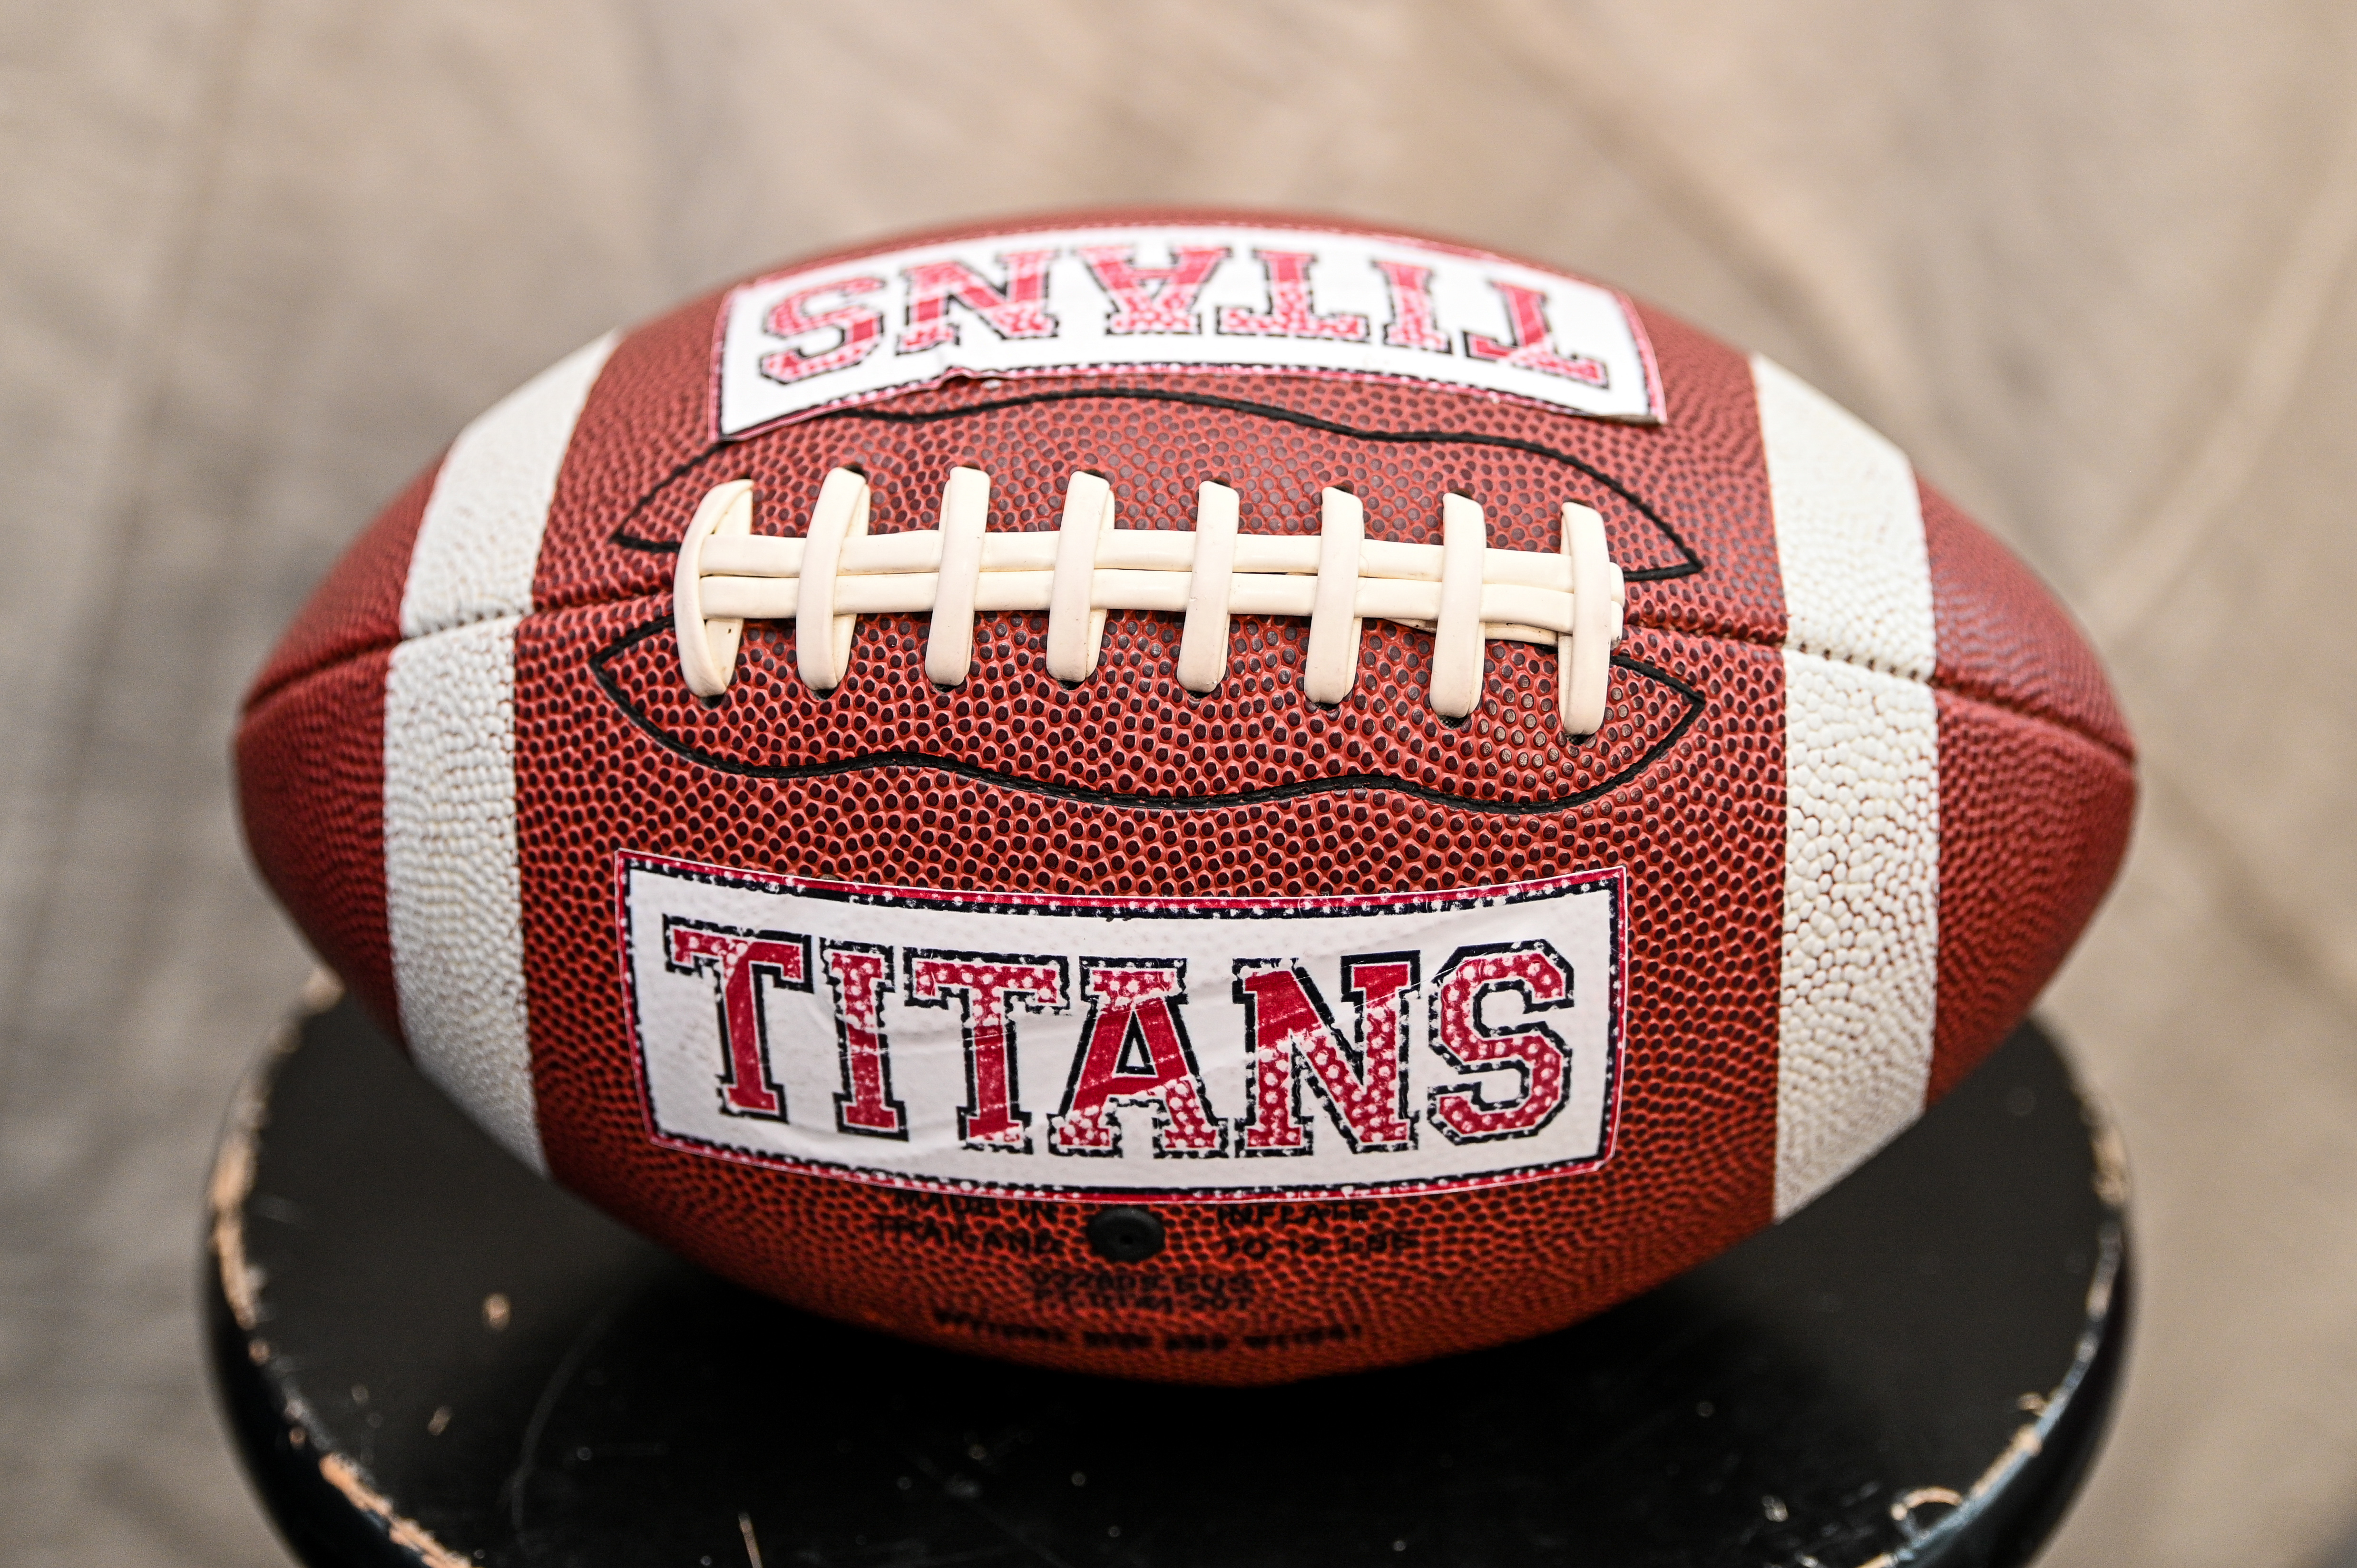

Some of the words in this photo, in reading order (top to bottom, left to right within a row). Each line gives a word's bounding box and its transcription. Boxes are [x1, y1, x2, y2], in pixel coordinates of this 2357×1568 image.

[762, 245, 1609, 387] TITANS
[662, 913, 1575, 1158] TITANS
[1217, 1200, 1373, 1226] INFLATE
